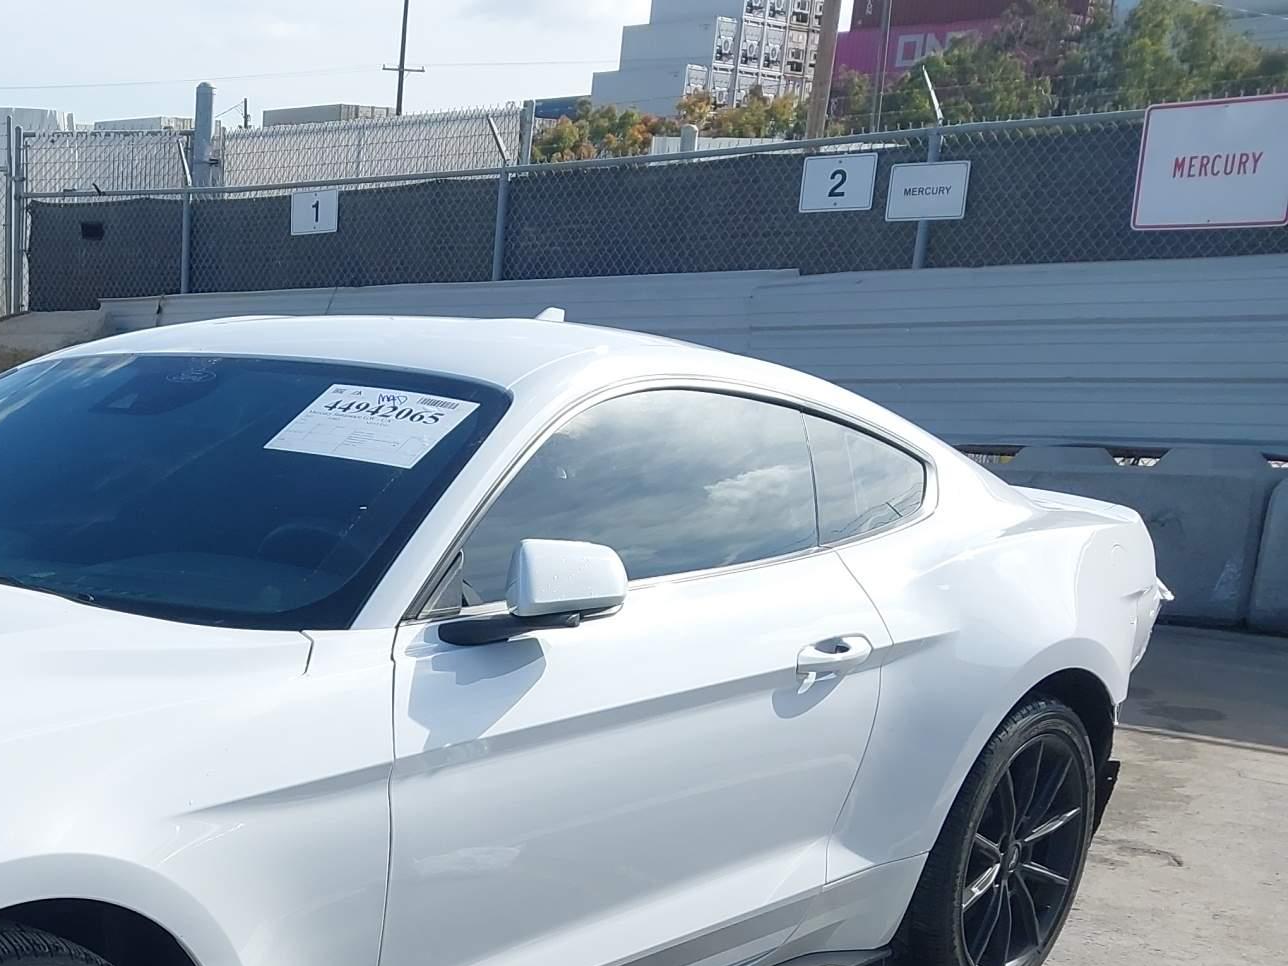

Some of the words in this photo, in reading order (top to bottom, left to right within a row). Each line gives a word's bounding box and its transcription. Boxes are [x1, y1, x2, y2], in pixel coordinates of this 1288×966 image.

[1172, 151, 1264, 179] MERCURY
[827, 168, 847, 198] 2
[903, 185, 952, 197] MERCURY
[311, 200, 320, 223] 1
[324, 399, 446, 425] 44942065
